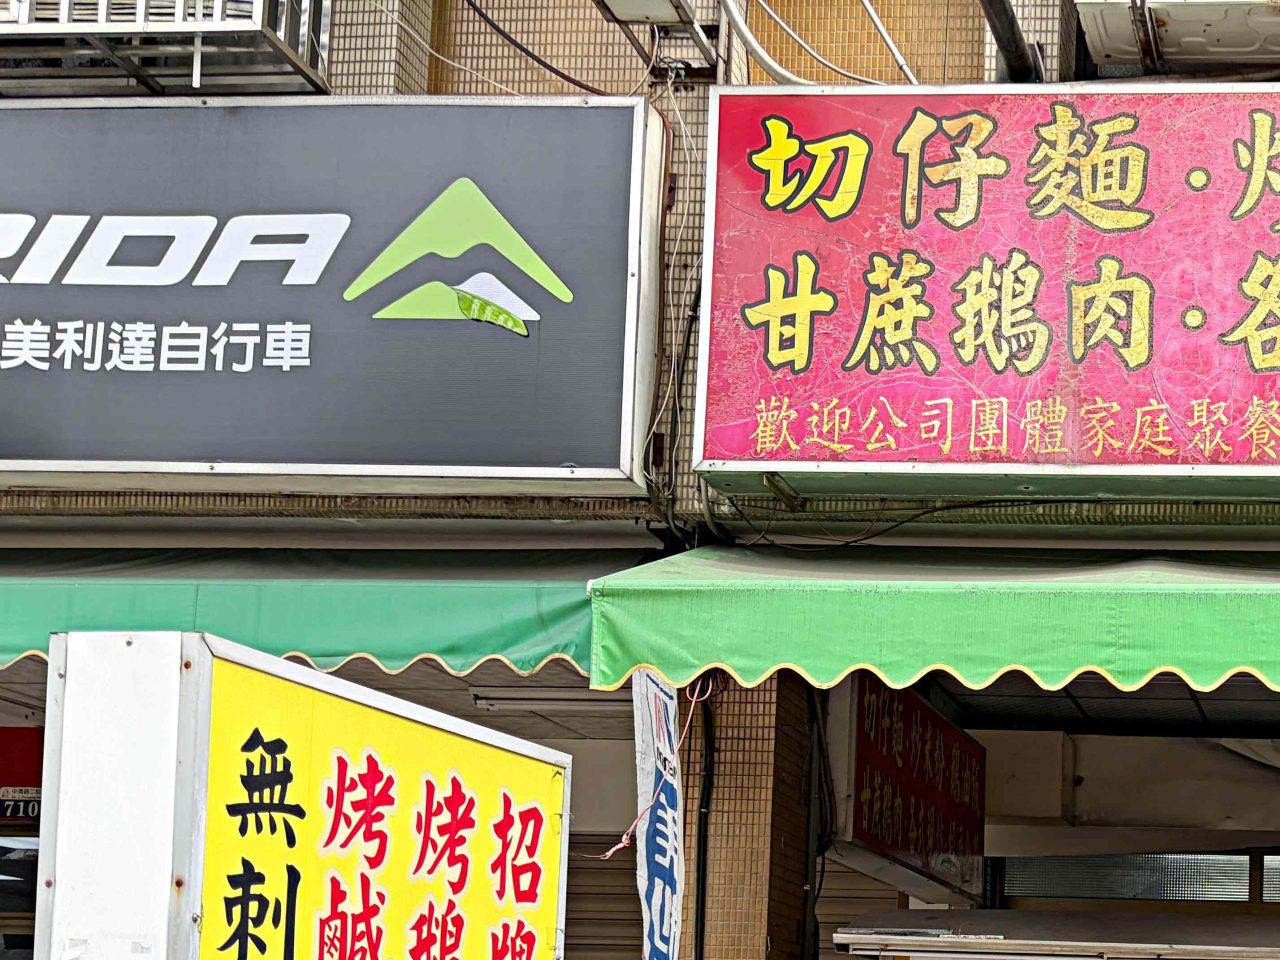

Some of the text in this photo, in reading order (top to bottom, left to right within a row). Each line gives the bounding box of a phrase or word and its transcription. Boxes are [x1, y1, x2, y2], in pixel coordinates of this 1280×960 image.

[2, 319, 312, 373] 美利達自行車
[5, 801, 38, 817] 710
